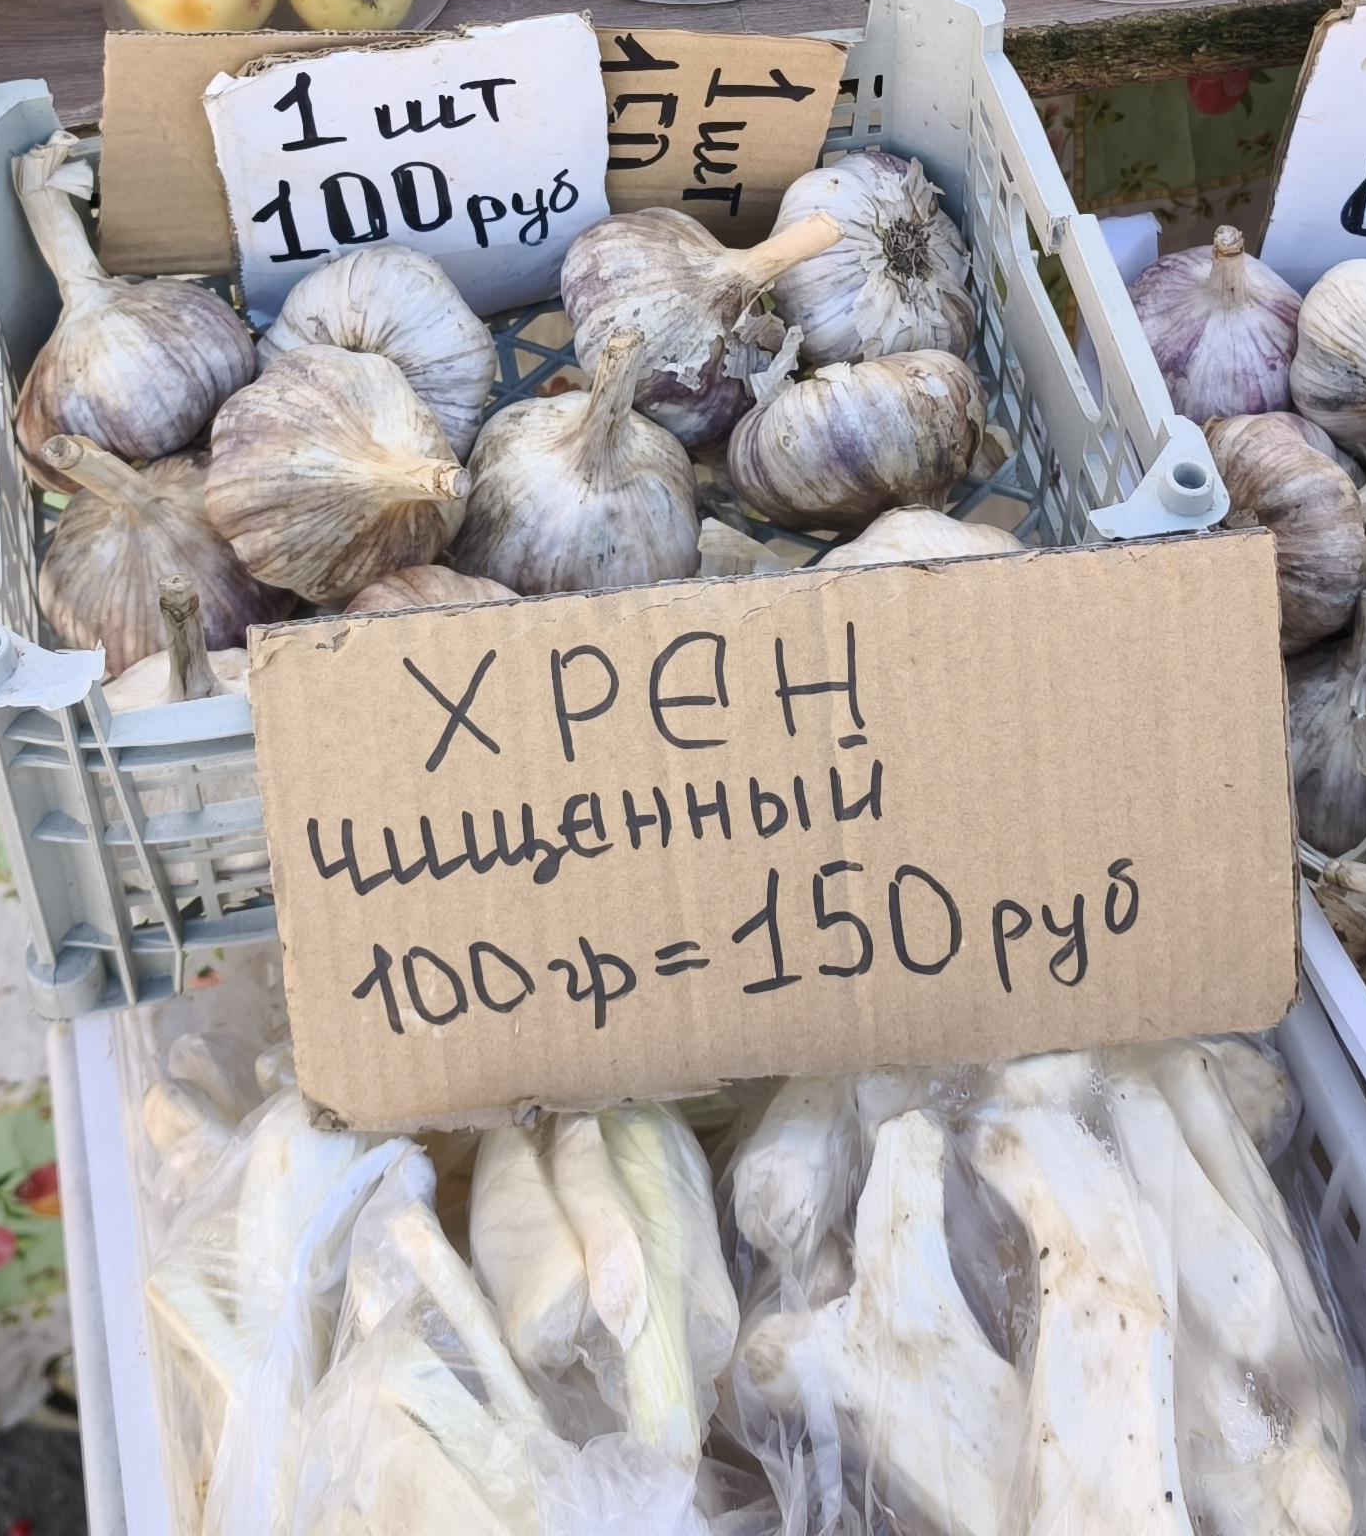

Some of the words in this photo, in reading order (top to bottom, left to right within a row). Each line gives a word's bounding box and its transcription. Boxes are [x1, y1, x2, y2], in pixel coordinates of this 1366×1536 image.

[273, 71, 347, 153] 1
[373, 76, 517, 140] шт
[251, 161, 453, 263] 100
[401, 620, 866, 773] ХРЕН
